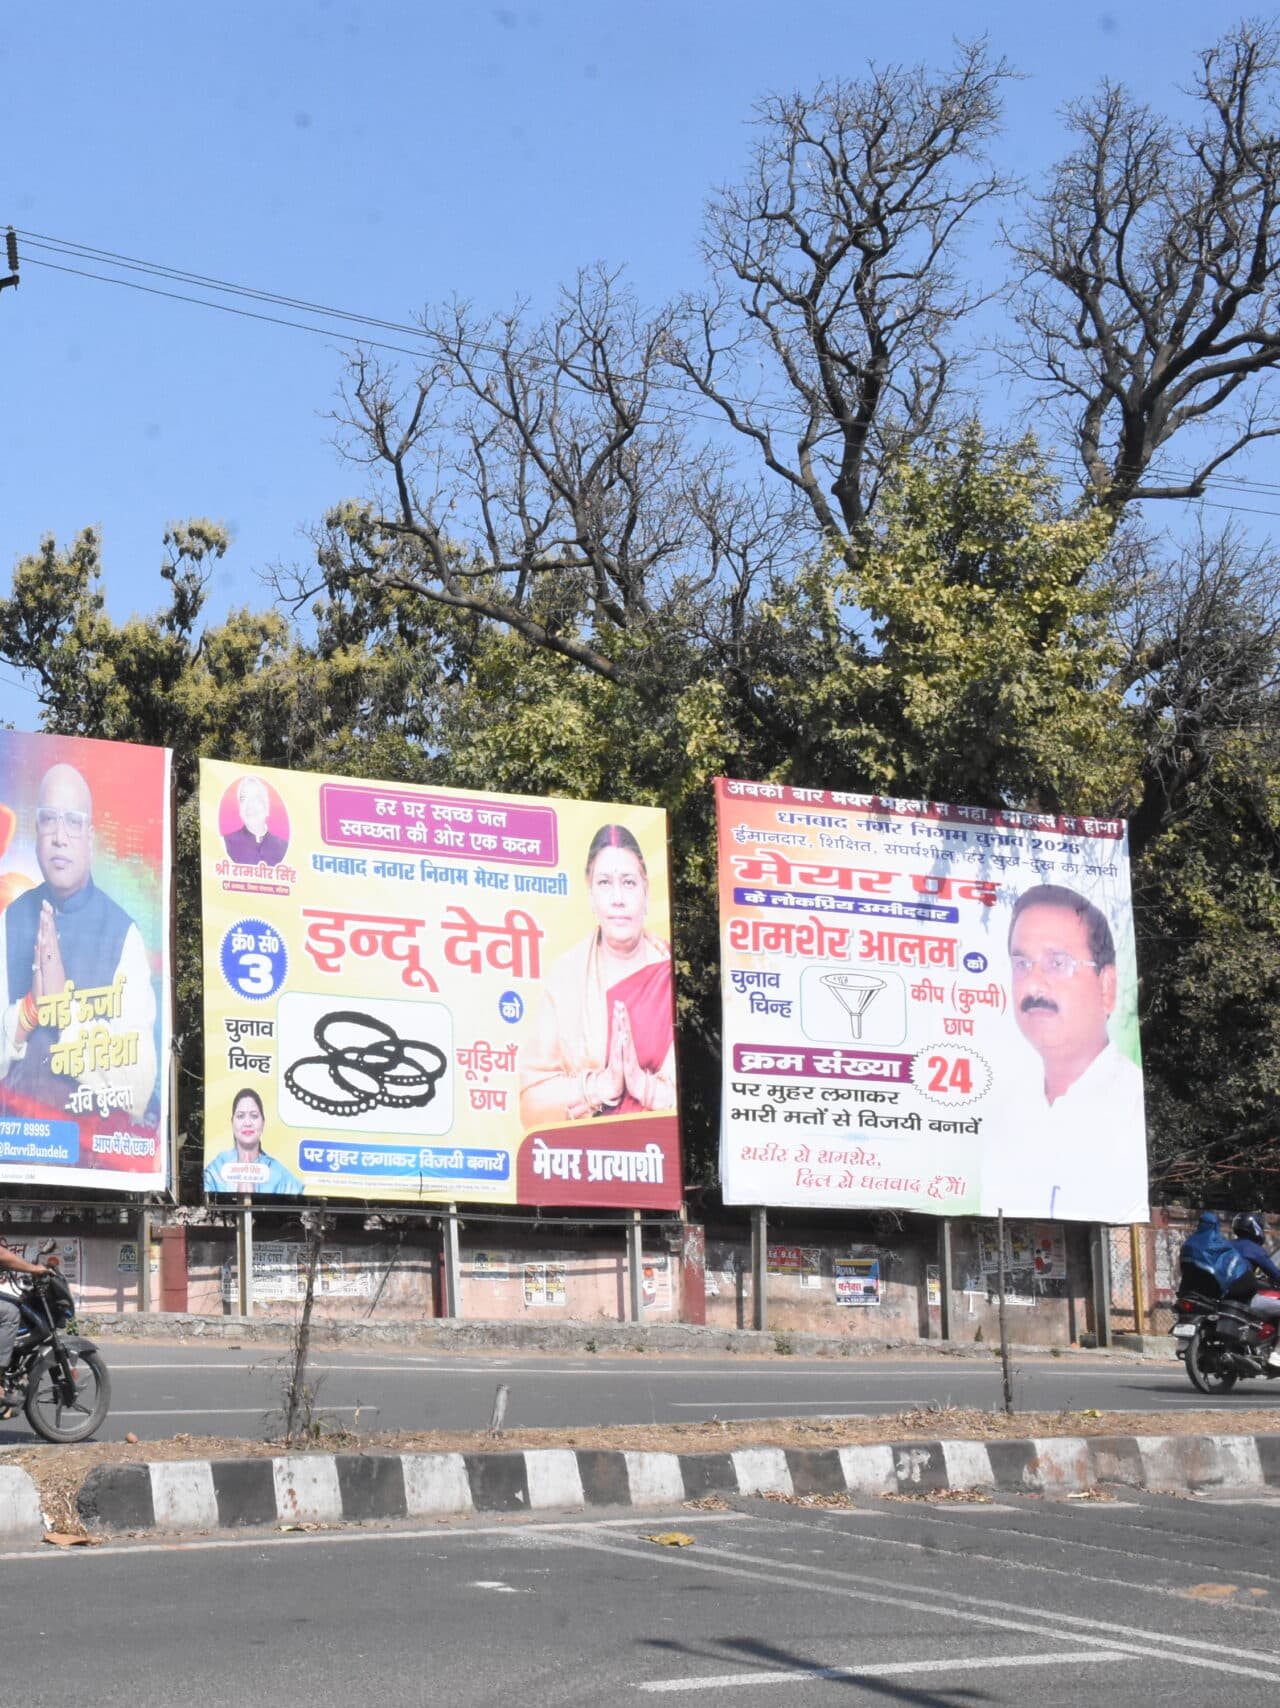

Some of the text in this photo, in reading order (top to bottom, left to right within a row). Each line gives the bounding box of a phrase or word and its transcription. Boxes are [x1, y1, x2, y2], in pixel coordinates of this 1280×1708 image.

[792, 787, 824, 803] बार
[374, 798, 507, 828] हर घर स्वच्छ जल
[777, 811, 848, 829] धनबाद
[857, 819, 903, 834] नगर
[911, 821, 967, 842] निगम
[976, 831, 1023, 848] चुनाव
[339, 819, 541, 855] स्वच्छता की ओर एक कदम
[312, 854, 568, 896] धनबाद नगर निगम मेयर प्रत्याशी
[734, 851, 1001, 907] मेयर पद
[966, 851, 1118, 878] हर का साथी
[744, 890, 950, 921] के लोकप्रिय उम्मीदवार
[303, 905, 545, 993] इन्दू देवी
[730, 916, 985, 971] शमशेर आलम को
[238, 954, 273, 994] 3
[730, 969, 944, 1004] चुनाव कीप
[37, 976, 126, 1029] नई ऊर्जा
[749, 991, 974, 1036] चिन्ह छाप
[225, 1018, 274, 1043] चुनाव
[50, 1027, 138, 1077] नई दिशा
[228, 1047, 272, 1073] चिन्ह
[740, 1050, 973, 1094] क्रम संख्या 24
[731, 1082, 901, 1105] पर मुहर लगाकर
[731, 1104, 983, 1135] भारी मतों से विजयी बनावें
[303, 1147, 463, 1170] पर मुहर लगाकर विजयी
[532, 1137, 664, 1184] मेयर प्रत्याशी
[741, 1142, 788, 1161] शरीर
[796, 1167, 830, 1188] दिल
